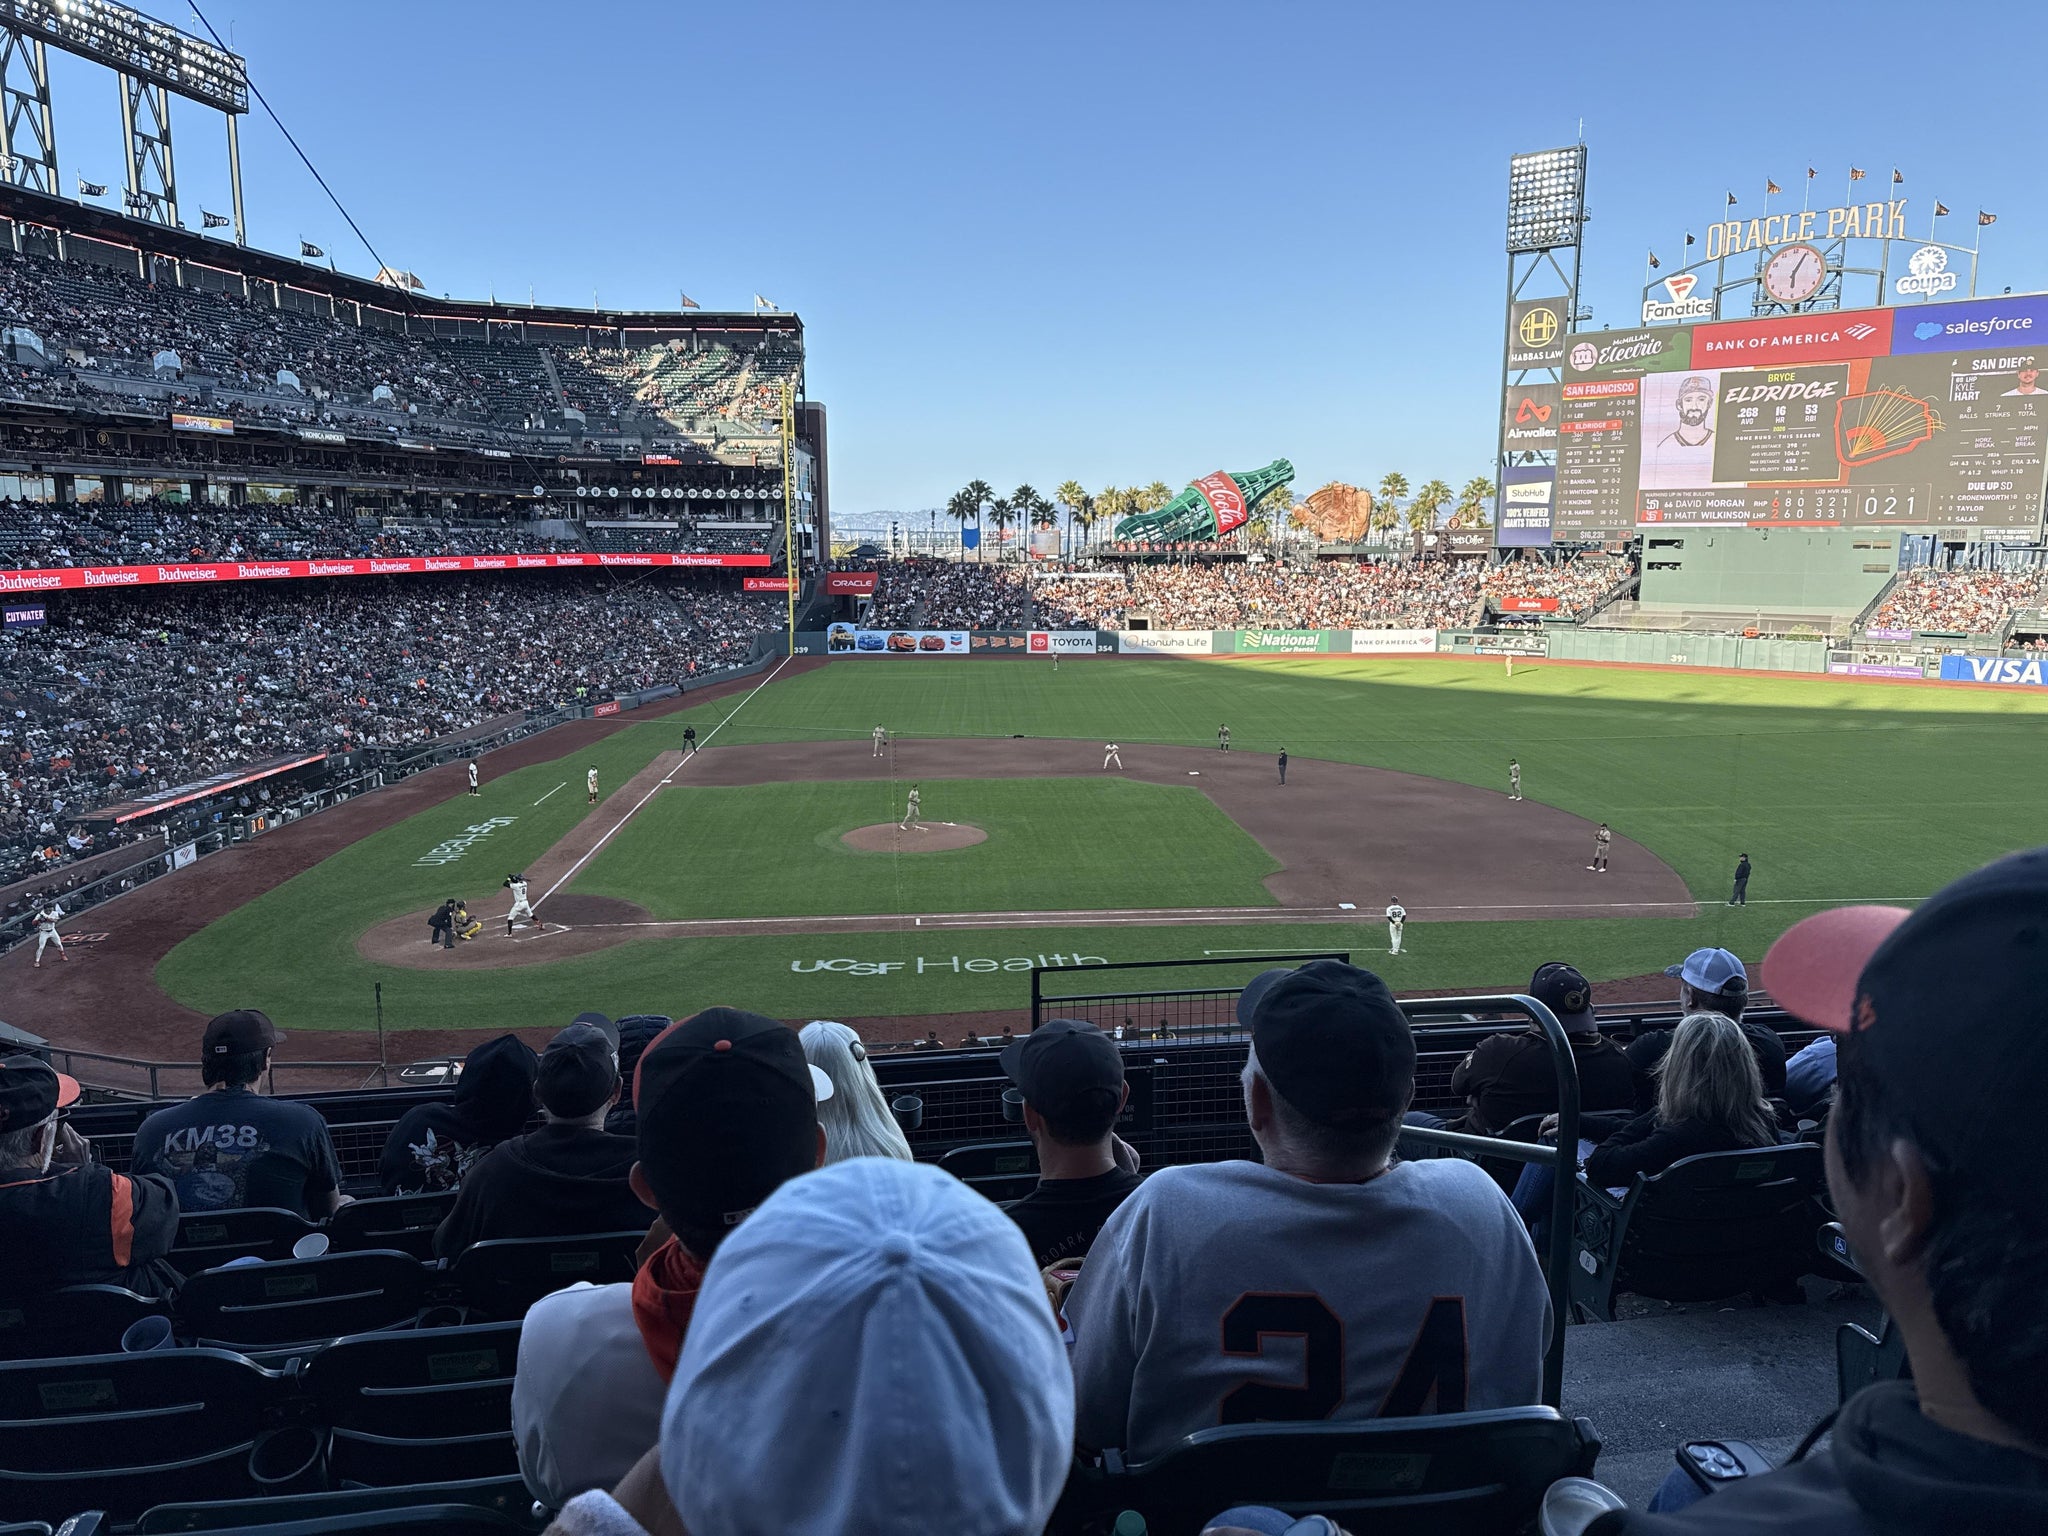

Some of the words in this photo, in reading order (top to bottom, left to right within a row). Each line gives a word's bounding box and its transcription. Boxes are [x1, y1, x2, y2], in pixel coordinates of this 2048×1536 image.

[1706, 211, 1816, 261] ORACLE
[1826, 198, 1909, 240] PARK
[1900, 275, 1953, 294] coupa
[1646, 300, 1713, 319] Fanatics
[1946, 315, 2033, 336] salesforce
[1612, 333, 1650, 346] McMILLAN
[1706, 339, 1745, 351] BANK
[1749, 338, 1767, 348] OF
[1771, 332, 1840, 346] AMERICA
[1511, 351, 1543, 362] HABBAS
[1545, 350, 1564, 360] LAW
[1599, 339, 1662, 364] Electric
[1972, 358, 1996, 371] SAN
[1768, 373, 1796, 383] BRYCE
[1566, 386, 1584, 396] SAN
[1585, 382, 1635, 394] FRANCISCO
[1725, 381, 1839, 404] ELDRIDGE
[1955, 383, 1976, 391] KYLE
[1954, 391, 1980, 401] HART
[1737, 407, 1759, 418] .268
[1775, 406, 1787, 416] 16
[1805, 404, 1818, 415] 53
[1575, 421, 1607, 429] ELDRIDGE
[306, 430, 324, 440] KONICA
[324, 432, 345, 442] MINOLTA
[1508, 427, 1557, 439] Airwallex
[1968, 482, 1985, 490] DUE
[1986, 482, 1999, 490] UP
[2001, 482, 2012, 490] SD
[1512, 489, 1544, 497] StubHub
[1706, 499, 1745, 507] MORGAN
[1772, 496, 1779, 508] 6
[1784, 498, 1792, 507] 8
[1797, 497, 1804, 507] 0
[1816, 498, 1823, 507] 3
[1829, 497, 1836, 507] 2
[1842, 496, 1848, 507] 1
[1865, 497, 1878, 515] 0
[1883, 497, 1898, 515] 2
[1907, 496, 1915, 515] 1
[1506, 508, 1522, 518] 100%
[1523, 507, 1549, 517] VERIFIED
[1675, 511, 1697, 519] MATT
[1701, 510, 1750, 519] WILKINSON
[1771, 508, 1779, 519] 2
[1784, 509, 1791, 518] 6
[1796, 509, 1803, 518] 0
[1815, 509, 1822, 518] 3
[1828, 509, 1835, 518] 3
[1842, 509, 1846, 518] 1
[1504, 518, 1525, 528] GIANTS
[1525, 518, 1550, 528] TICKETS
[1465, 534, 1485, 545] Coffee
[1580, 530, 1605, 539] $16,235
[832, 579, 873, 588] ORACLE
[1518, 600, 1542, 609] Adobe
[6, 610, 44, 623] CUTWATER
[1052, 637, 1093, 647] TOYOTA
[1141, 637, 1185, 647] Hanwha
[1187, 637, 1207, 647] Life
[1261, 633, 1320, 646] National
[1386, 638, 1418, 646] AMERICA
[794, 646, 809, 654] 339
[1097, 645, 1113, 653] 354
[1670, 654, 1688, 663] 391
[1965, 659, 2043, 684] VISA
[598, 703, 618, 715] ORACLE
[791, 958, 906, 975] UCSF
[917, 952, 1110, 974] Health
[164, 1124, 258, 1154] KM38
[1041, 1231, 1086, 1266] ROARK
[1218, 1289, 1469, 1424] 24
